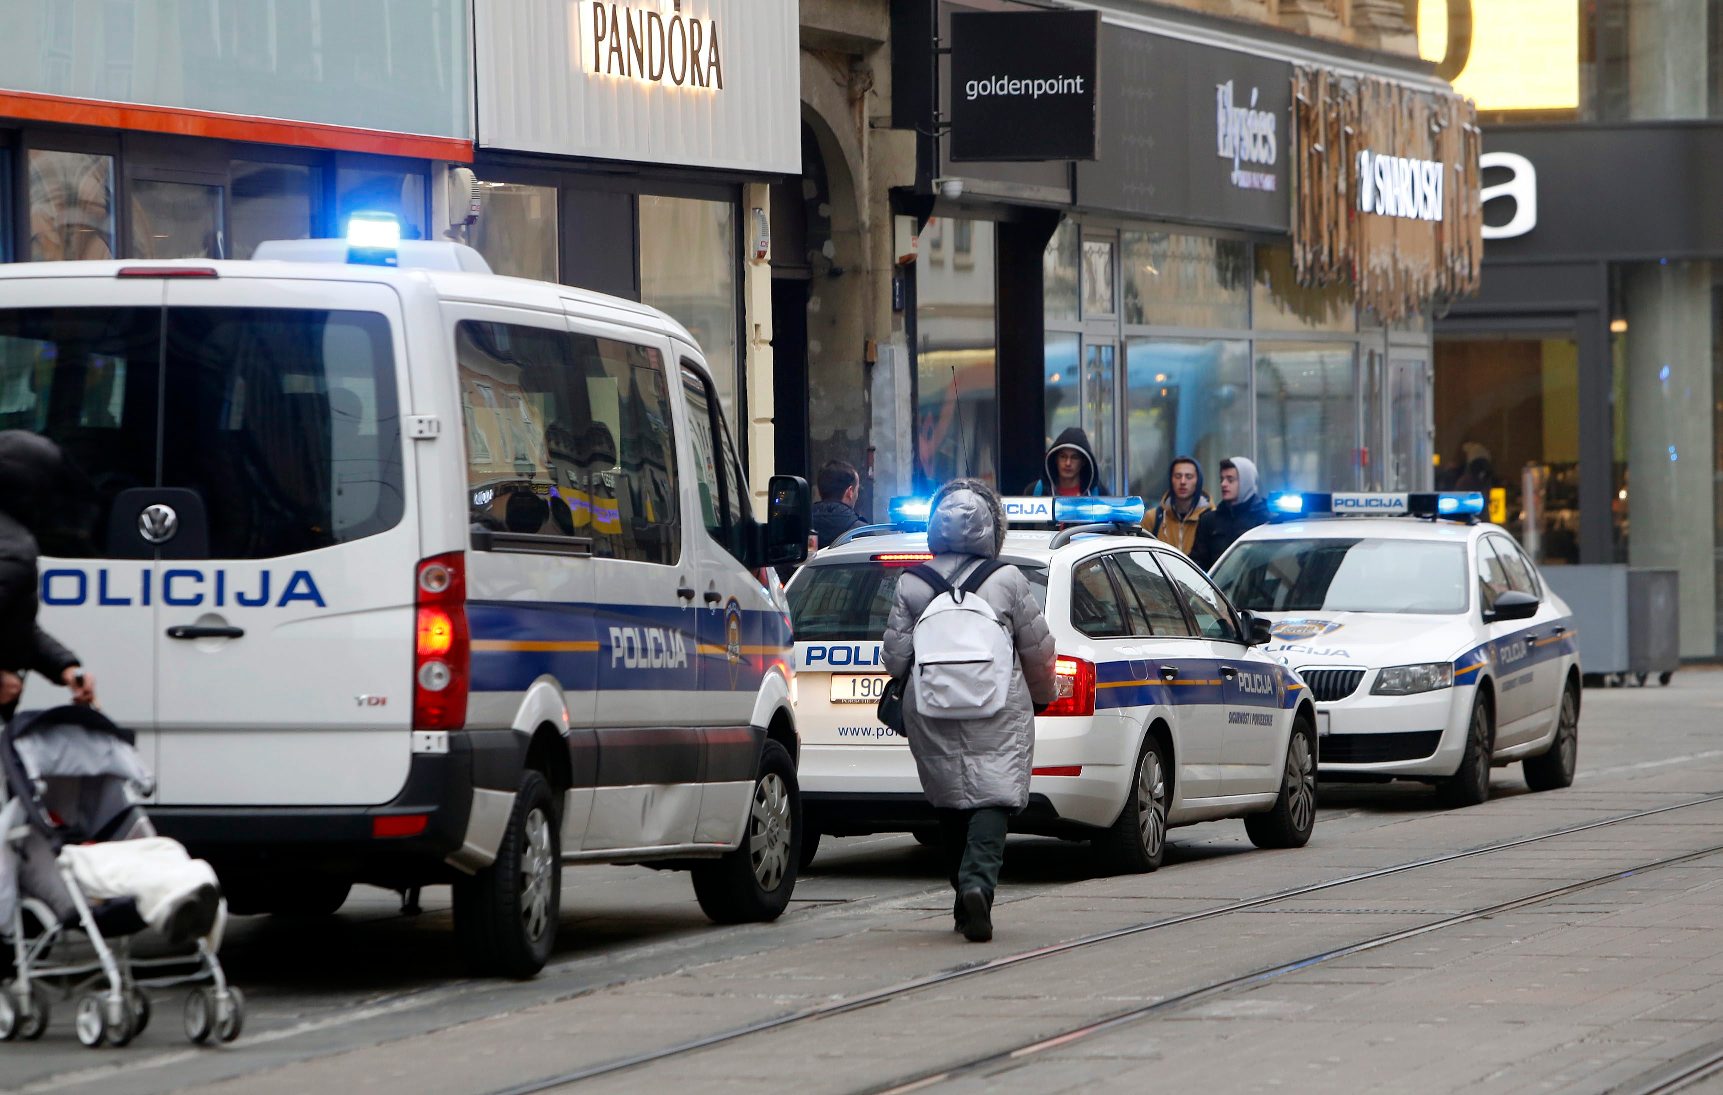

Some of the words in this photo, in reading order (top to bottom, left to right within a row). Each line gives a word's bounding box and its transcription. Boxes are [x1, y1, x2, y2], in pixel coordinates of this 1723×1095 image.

[593, 2, 723, 90] PANDORA
[965, 75, 1084, 100] goldenpoint
[1334, 498, 1403, 508] POLICIJA
[42, 569, 327, 608] OLICIJA
[609, 626, 688, 669] POLICIJA
[851, 678, 884, 697] 190
[1238, 672, 1273, 695] POLICIJA
